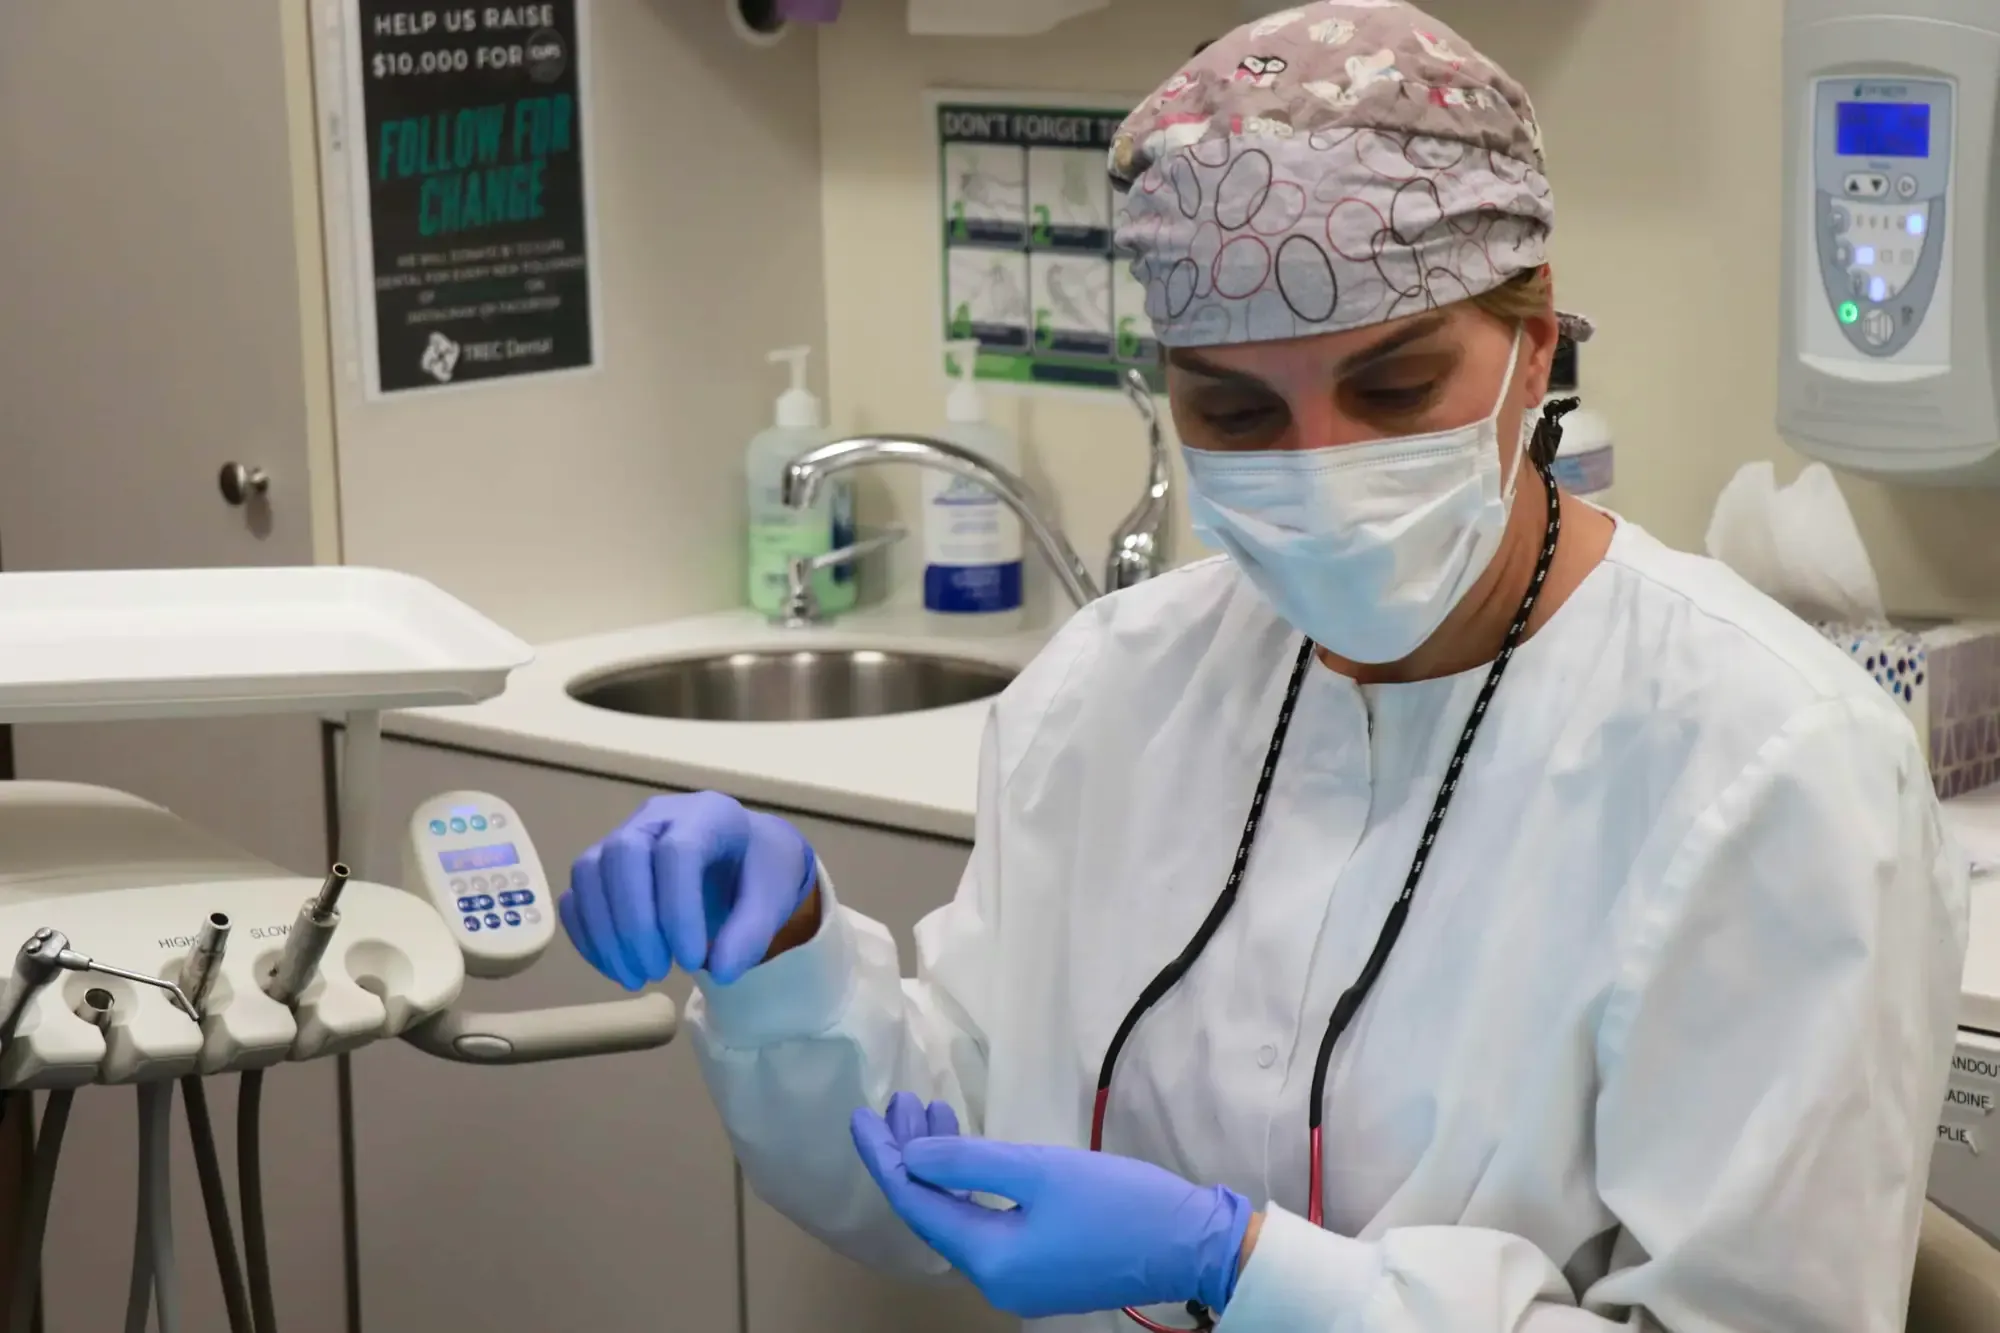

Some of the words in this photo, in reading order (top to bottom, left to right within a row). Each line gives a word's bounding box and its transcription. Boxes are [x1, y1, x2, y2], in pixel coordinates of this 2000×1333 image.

[373, 11, 437, 36] HELP
[443, 7, 476, 33] US
[482, 4, 554, 30] RAISE
[476, 44, 523, 69] FOR
[379, 103, 506, 181] FOLLOW
[513, 93, 571, 158] FOR
[944, 111, 1007, 138] DON'T
[1011, 114, 1091, 143] FORGET
[419, 159, 547, 237] CHANGE
[505, 335, 553, 360] Dental
[250, 924, 293, 939] SLOW
